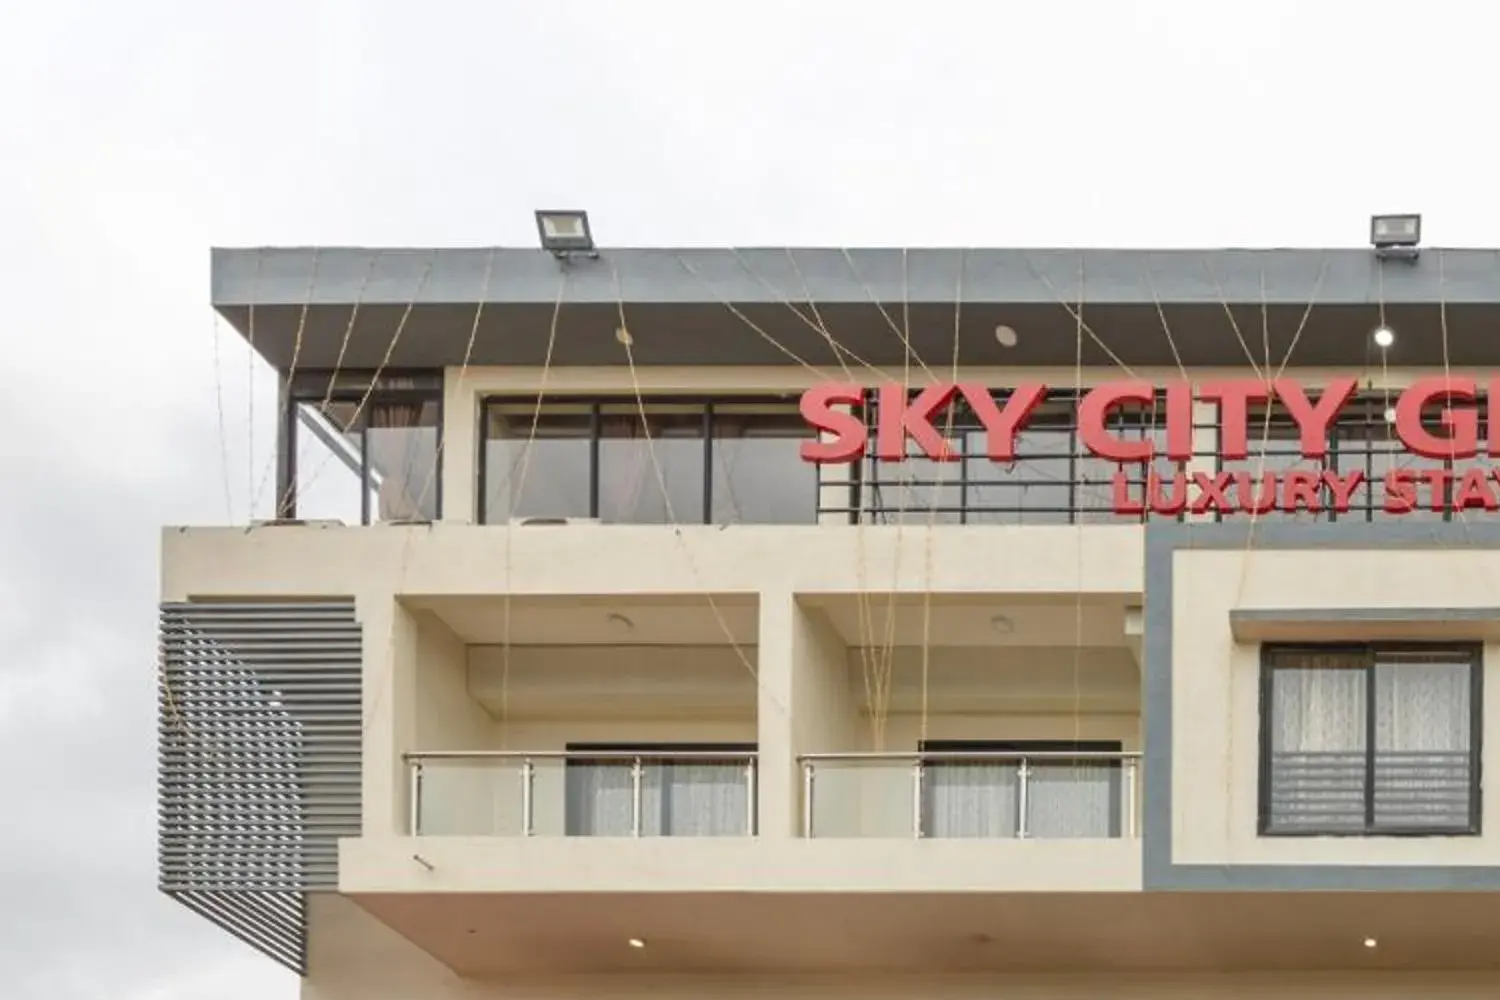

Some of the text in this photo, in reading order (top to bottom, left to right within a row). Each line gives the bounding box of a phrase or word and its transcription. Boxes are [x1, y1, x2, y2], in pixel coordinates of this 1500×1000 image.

[800, 383, 1046, 463] SKY
[1074, 379, 1356, 459] CITY
[1111, 472, 1367, 516] LUXURY
